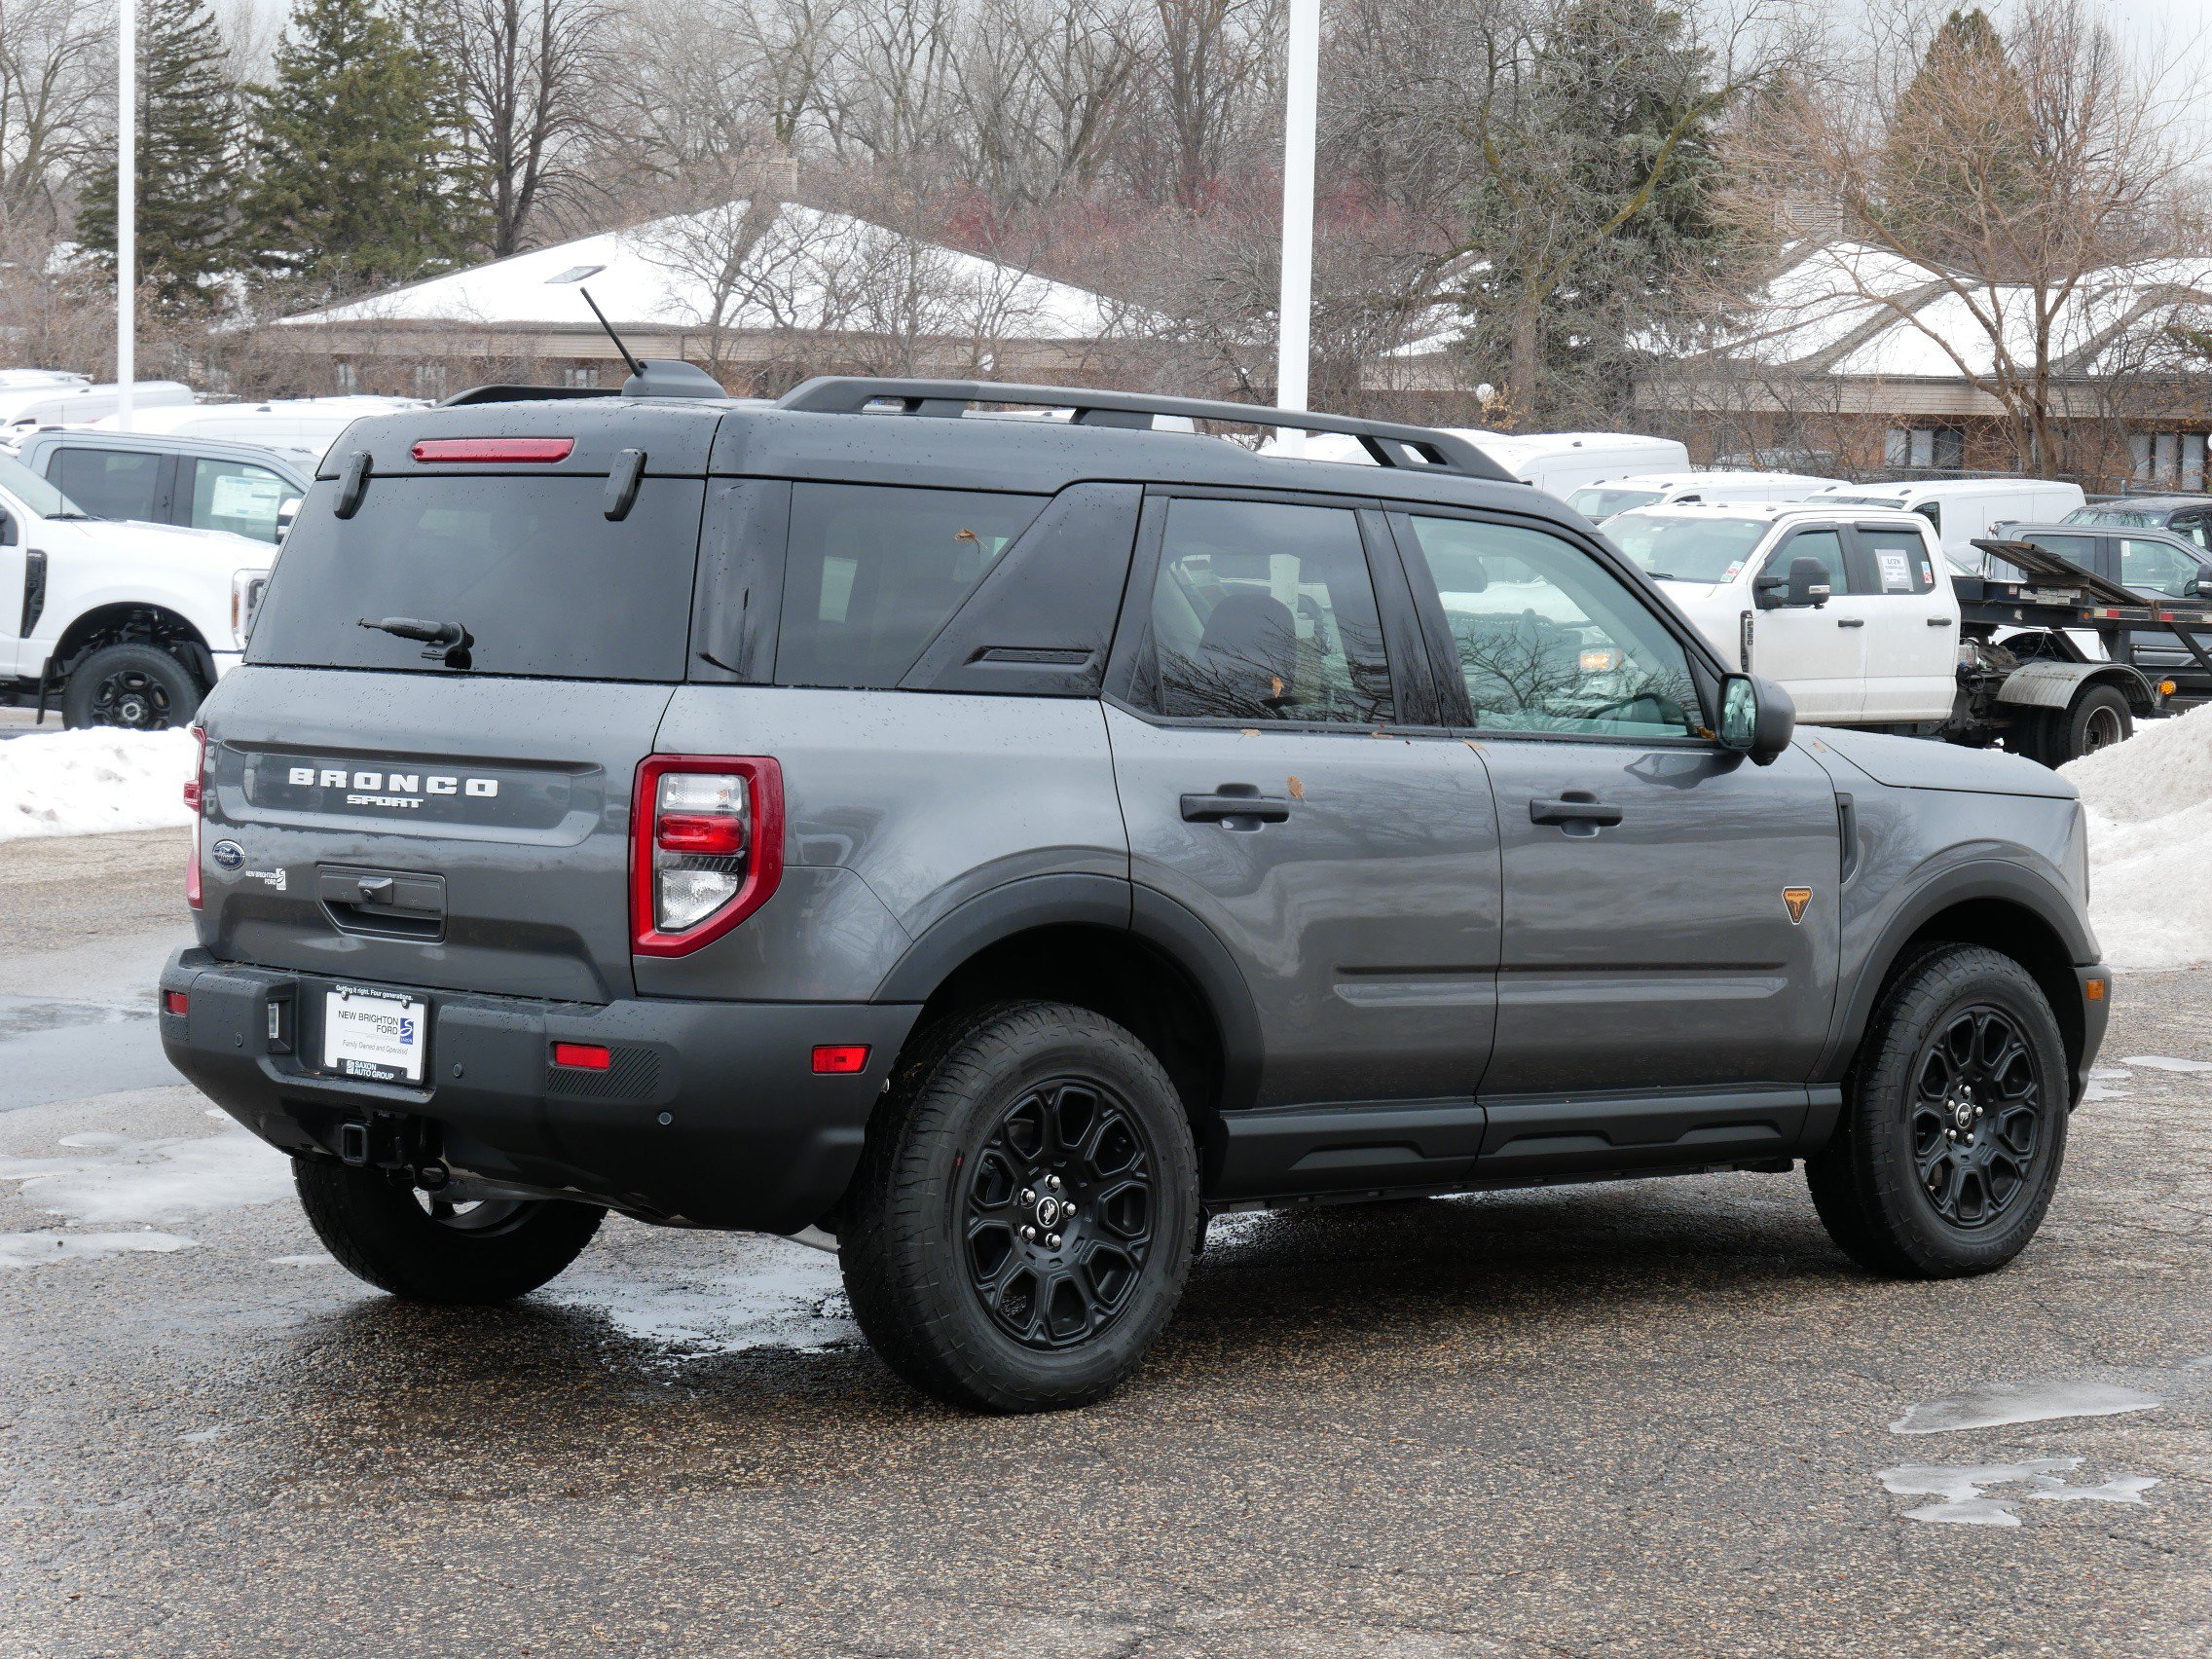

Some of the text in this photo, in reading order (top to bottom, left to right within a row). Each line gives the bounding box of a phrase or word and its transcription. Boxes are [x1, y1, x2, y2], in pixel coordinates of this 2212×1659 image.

[289, 767, 498, 797] BRONCO
[347, 794, 424, 808] SPORT
[336, 984, 353, 993] Getting
[338, 1011, 399, 1026] NEW BRIGHTON
[377, 1024, 398, 1035] FORD
[343, 1039, 358, 1049] Family
[358, 1042, 375, 1051] Owned
[386, 1046, 409, 1055] Operated
[354, 1060, 377, 1070] SAXON
[353, 1068, 394, 1081] AUTO GROUP
